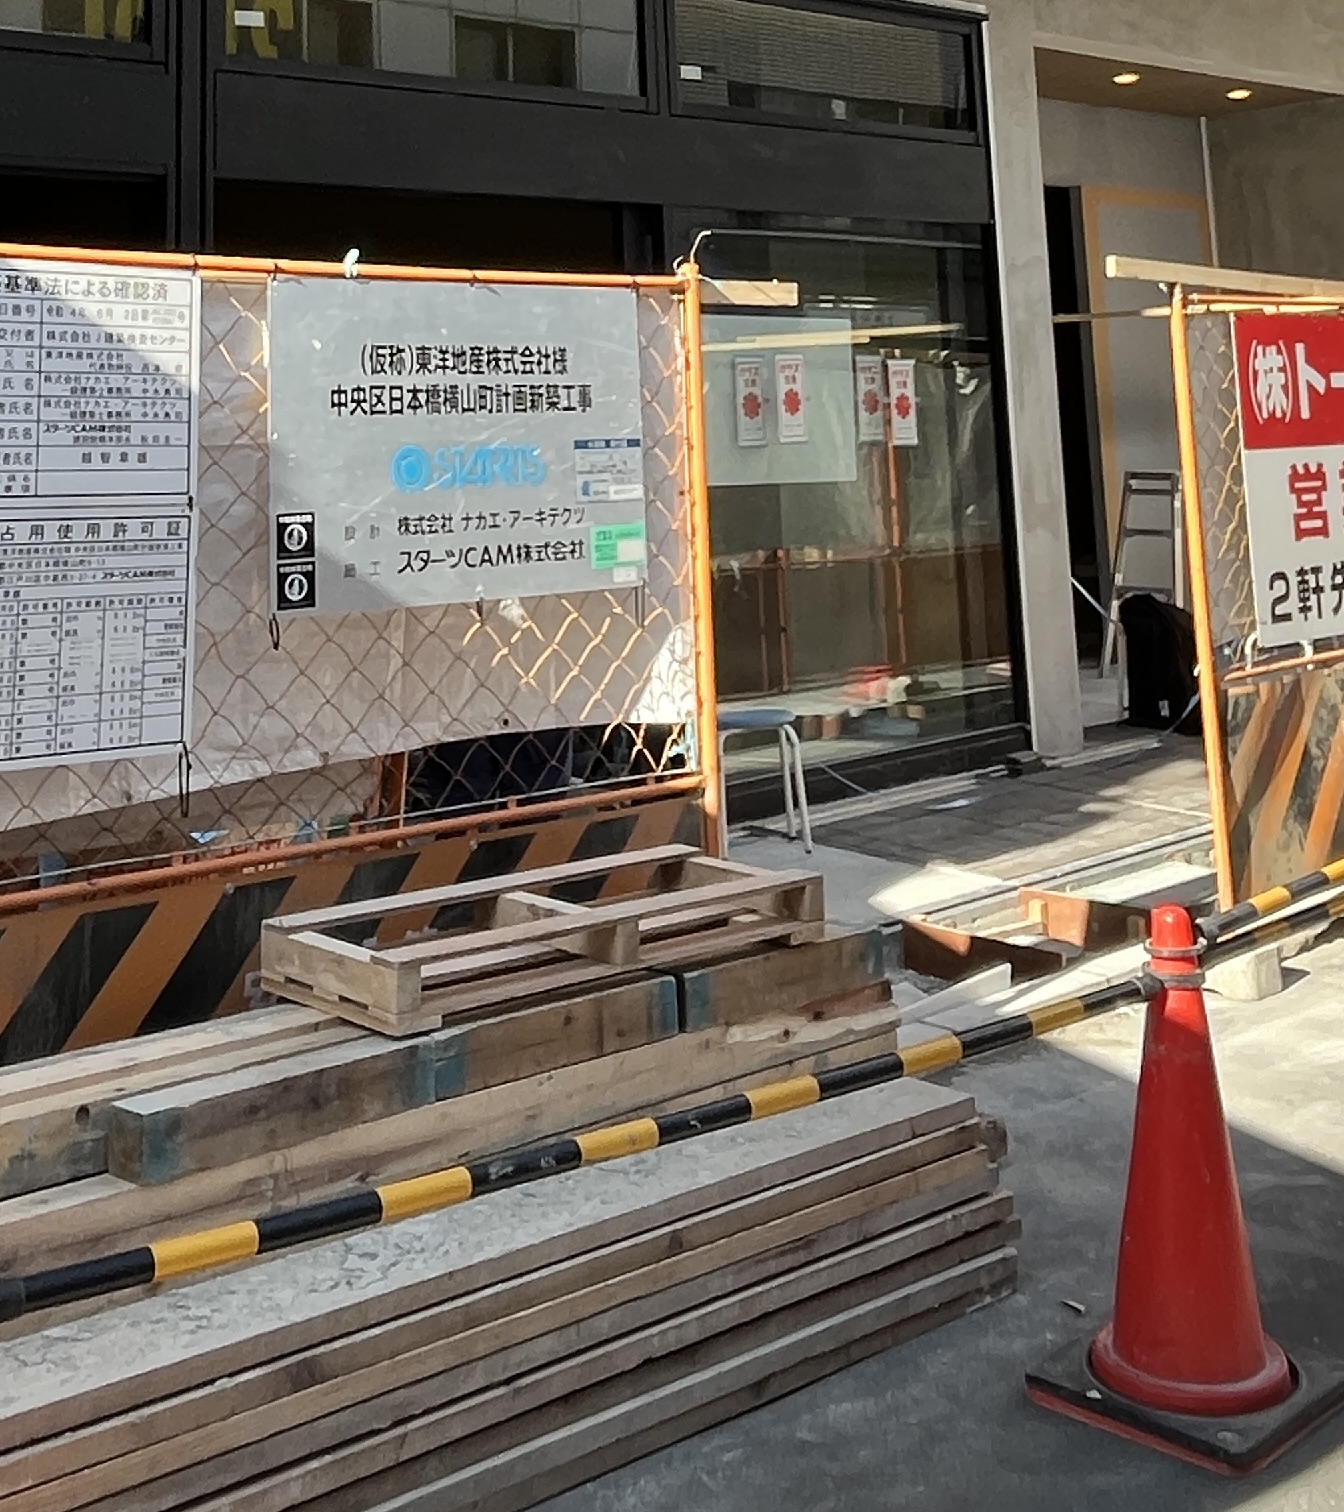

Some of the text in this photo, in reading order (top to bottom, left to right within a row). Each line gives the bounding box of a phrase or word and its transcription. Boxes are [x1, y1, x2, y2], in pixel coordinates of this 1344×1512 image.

[360, 344, 569, 377] (仮称)東洋地産株式会社様
[330, 384, 593, 417] 中央区日本橋横山町計画新築工事
[432, 443, 547, 489] STARTS
[397, 512, 455, 536] 株式会社
[460, 507, 586, 532] ナカエ・アーキテクツ
[397, 539, 586, 575] スターツCAM株式会社
